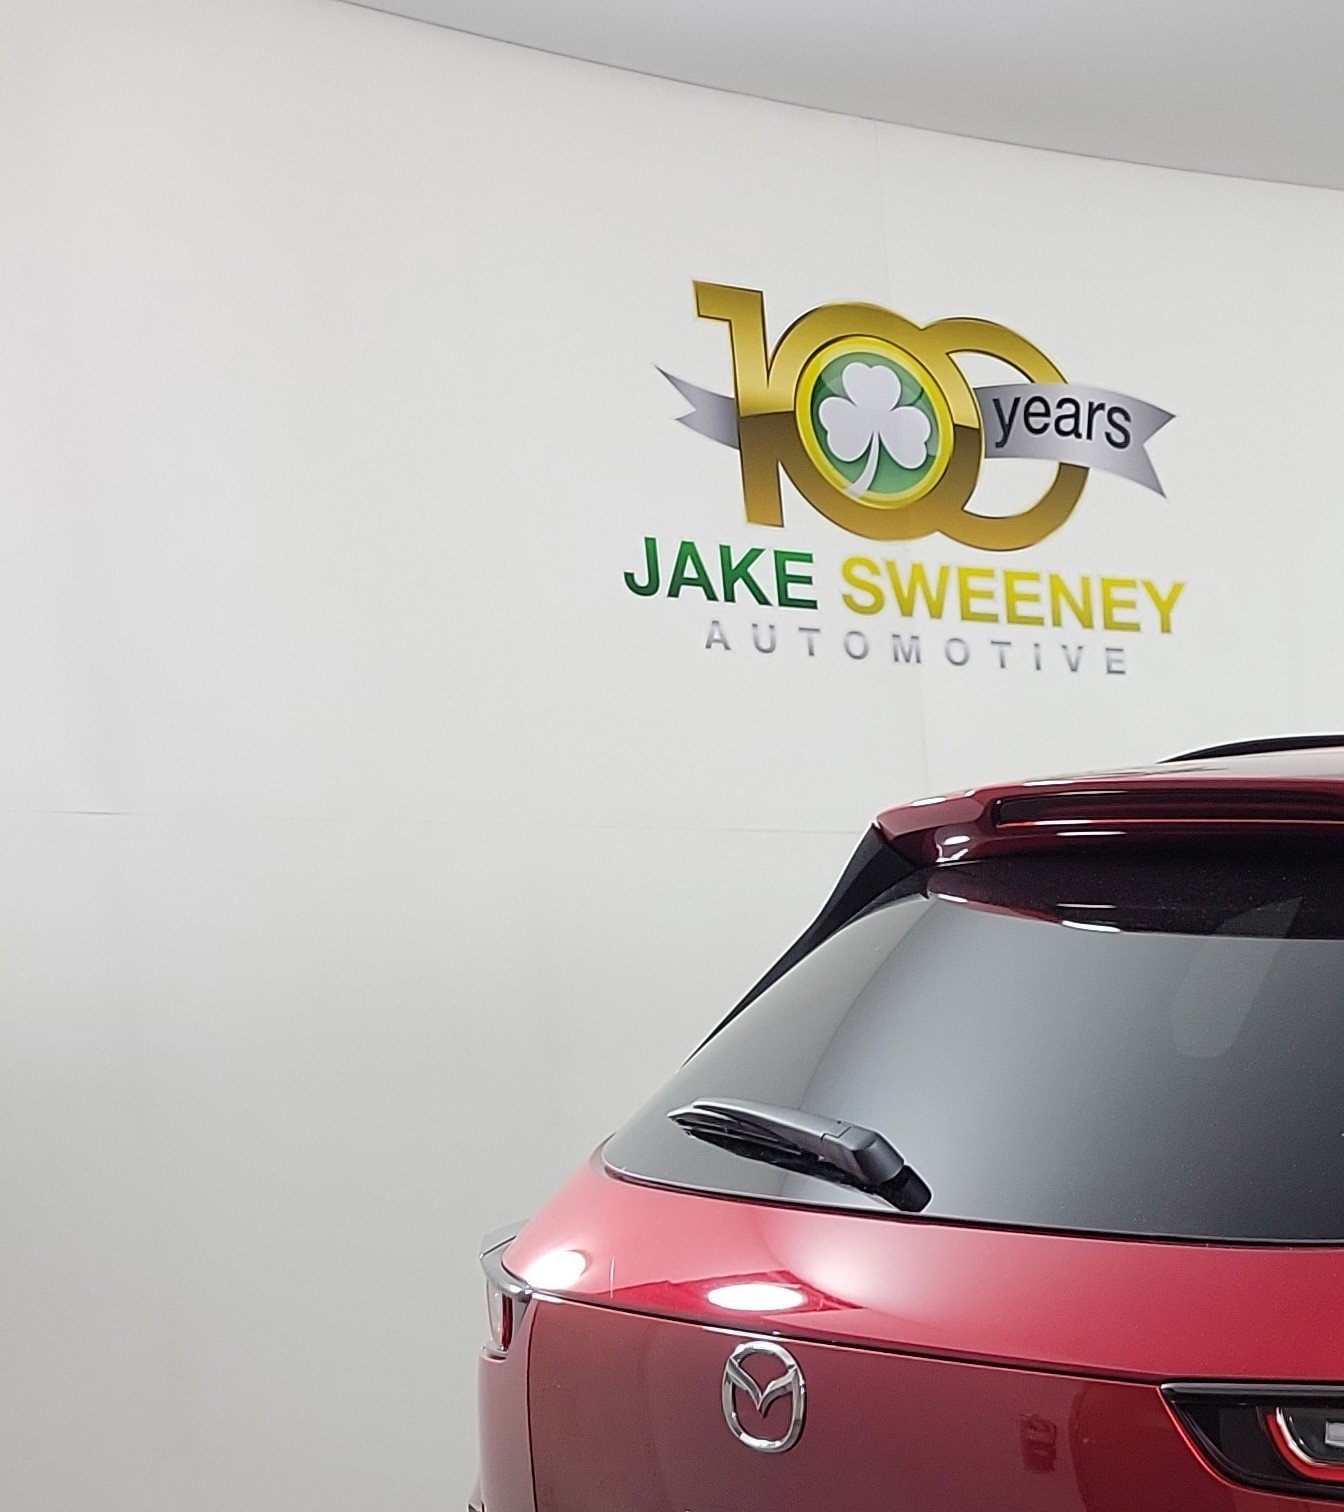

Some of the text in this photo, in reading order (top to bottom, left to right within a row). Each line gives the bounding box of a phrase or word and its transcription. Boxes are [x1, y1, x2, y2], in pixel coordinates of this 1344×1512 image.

[991, 393, 1133, 450] years
[623, 536, 1187, 635] JAKE SWEENEY
[704, 619, 1127, 676] AUTOMOTIVE
